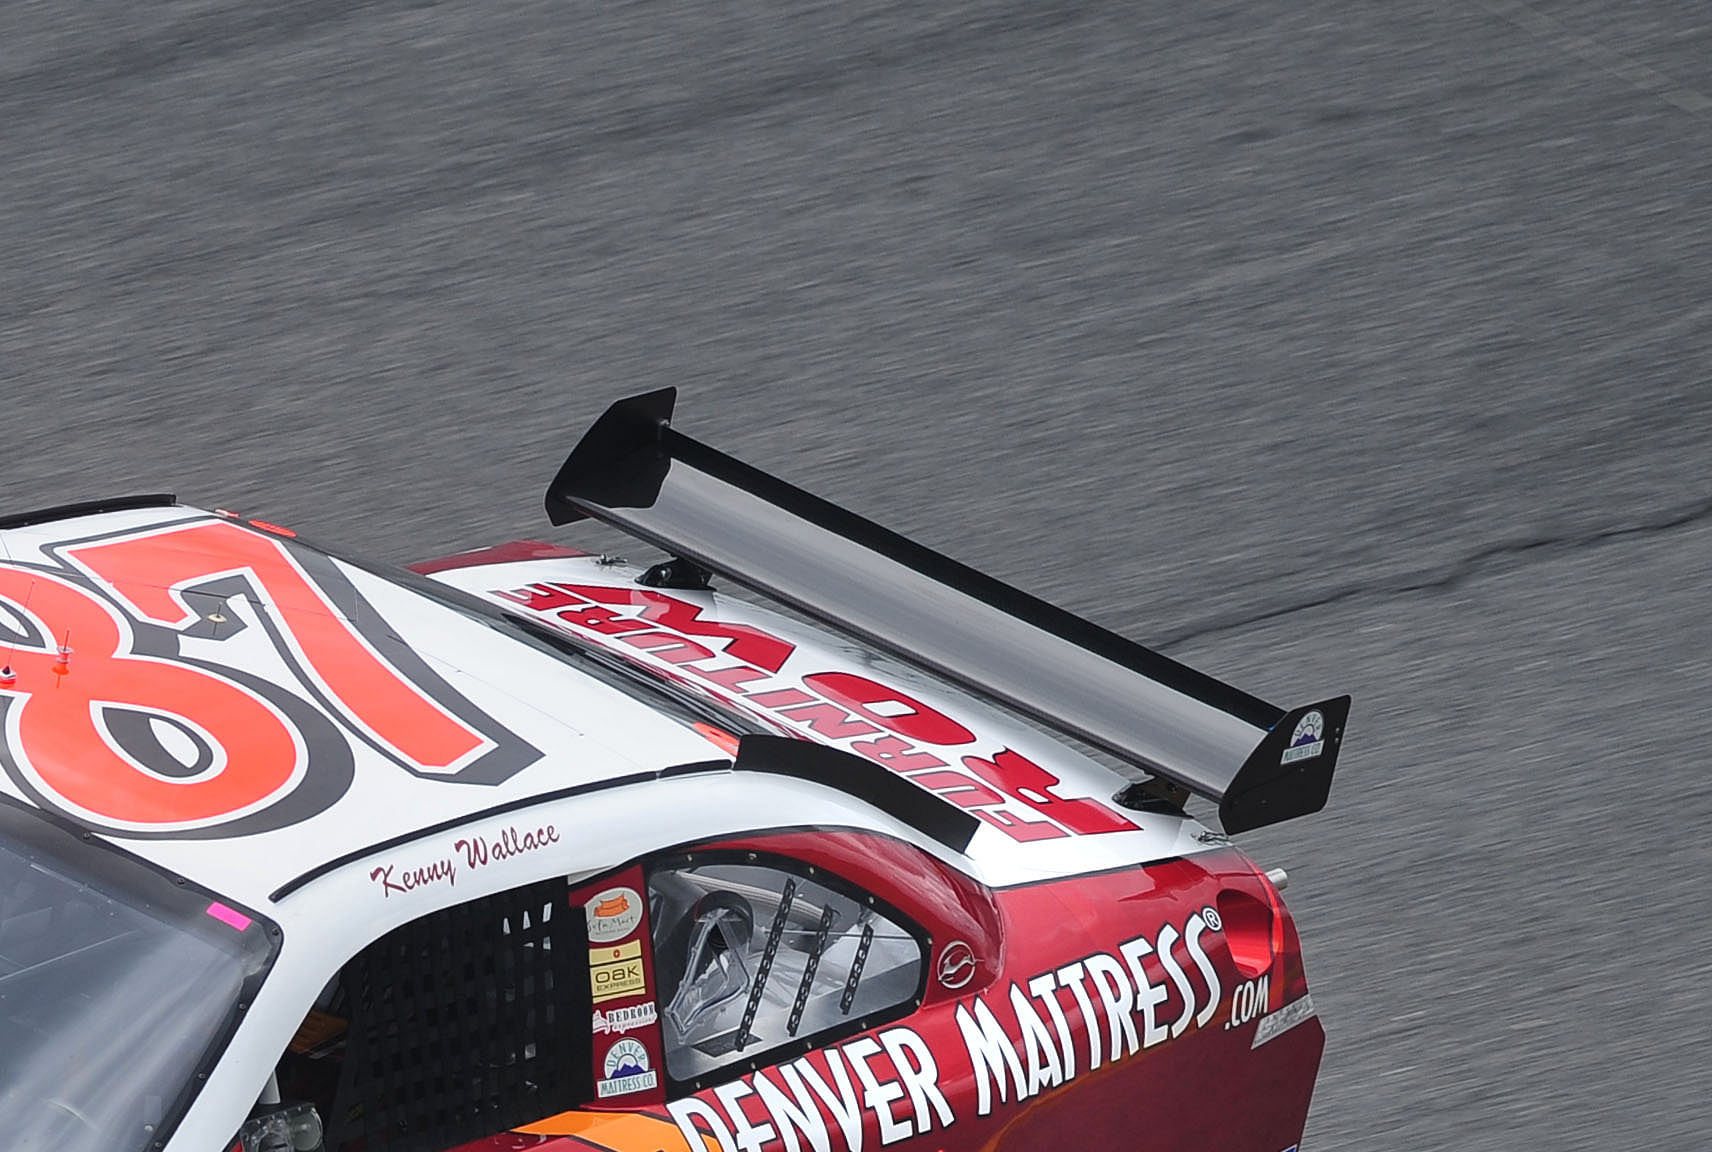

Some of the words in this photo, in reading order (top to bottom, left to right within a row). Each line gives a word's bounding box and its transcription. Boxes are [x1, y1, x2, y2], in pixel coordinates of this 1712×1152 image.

[493, 582, 1073, 843] FURNITURE
[548, 581, 1145, 836] ROW
[370, 860, 457, 897] Kenny
[453, 824, 560, 870] Wallace
[596, 977, 642, 992] EXPRESS
[1223, 975, 1271, 1032] .COM
[606, 1041, 646, 1068] DENVER
[600, 1076, 641, 1096] MATTRESS
